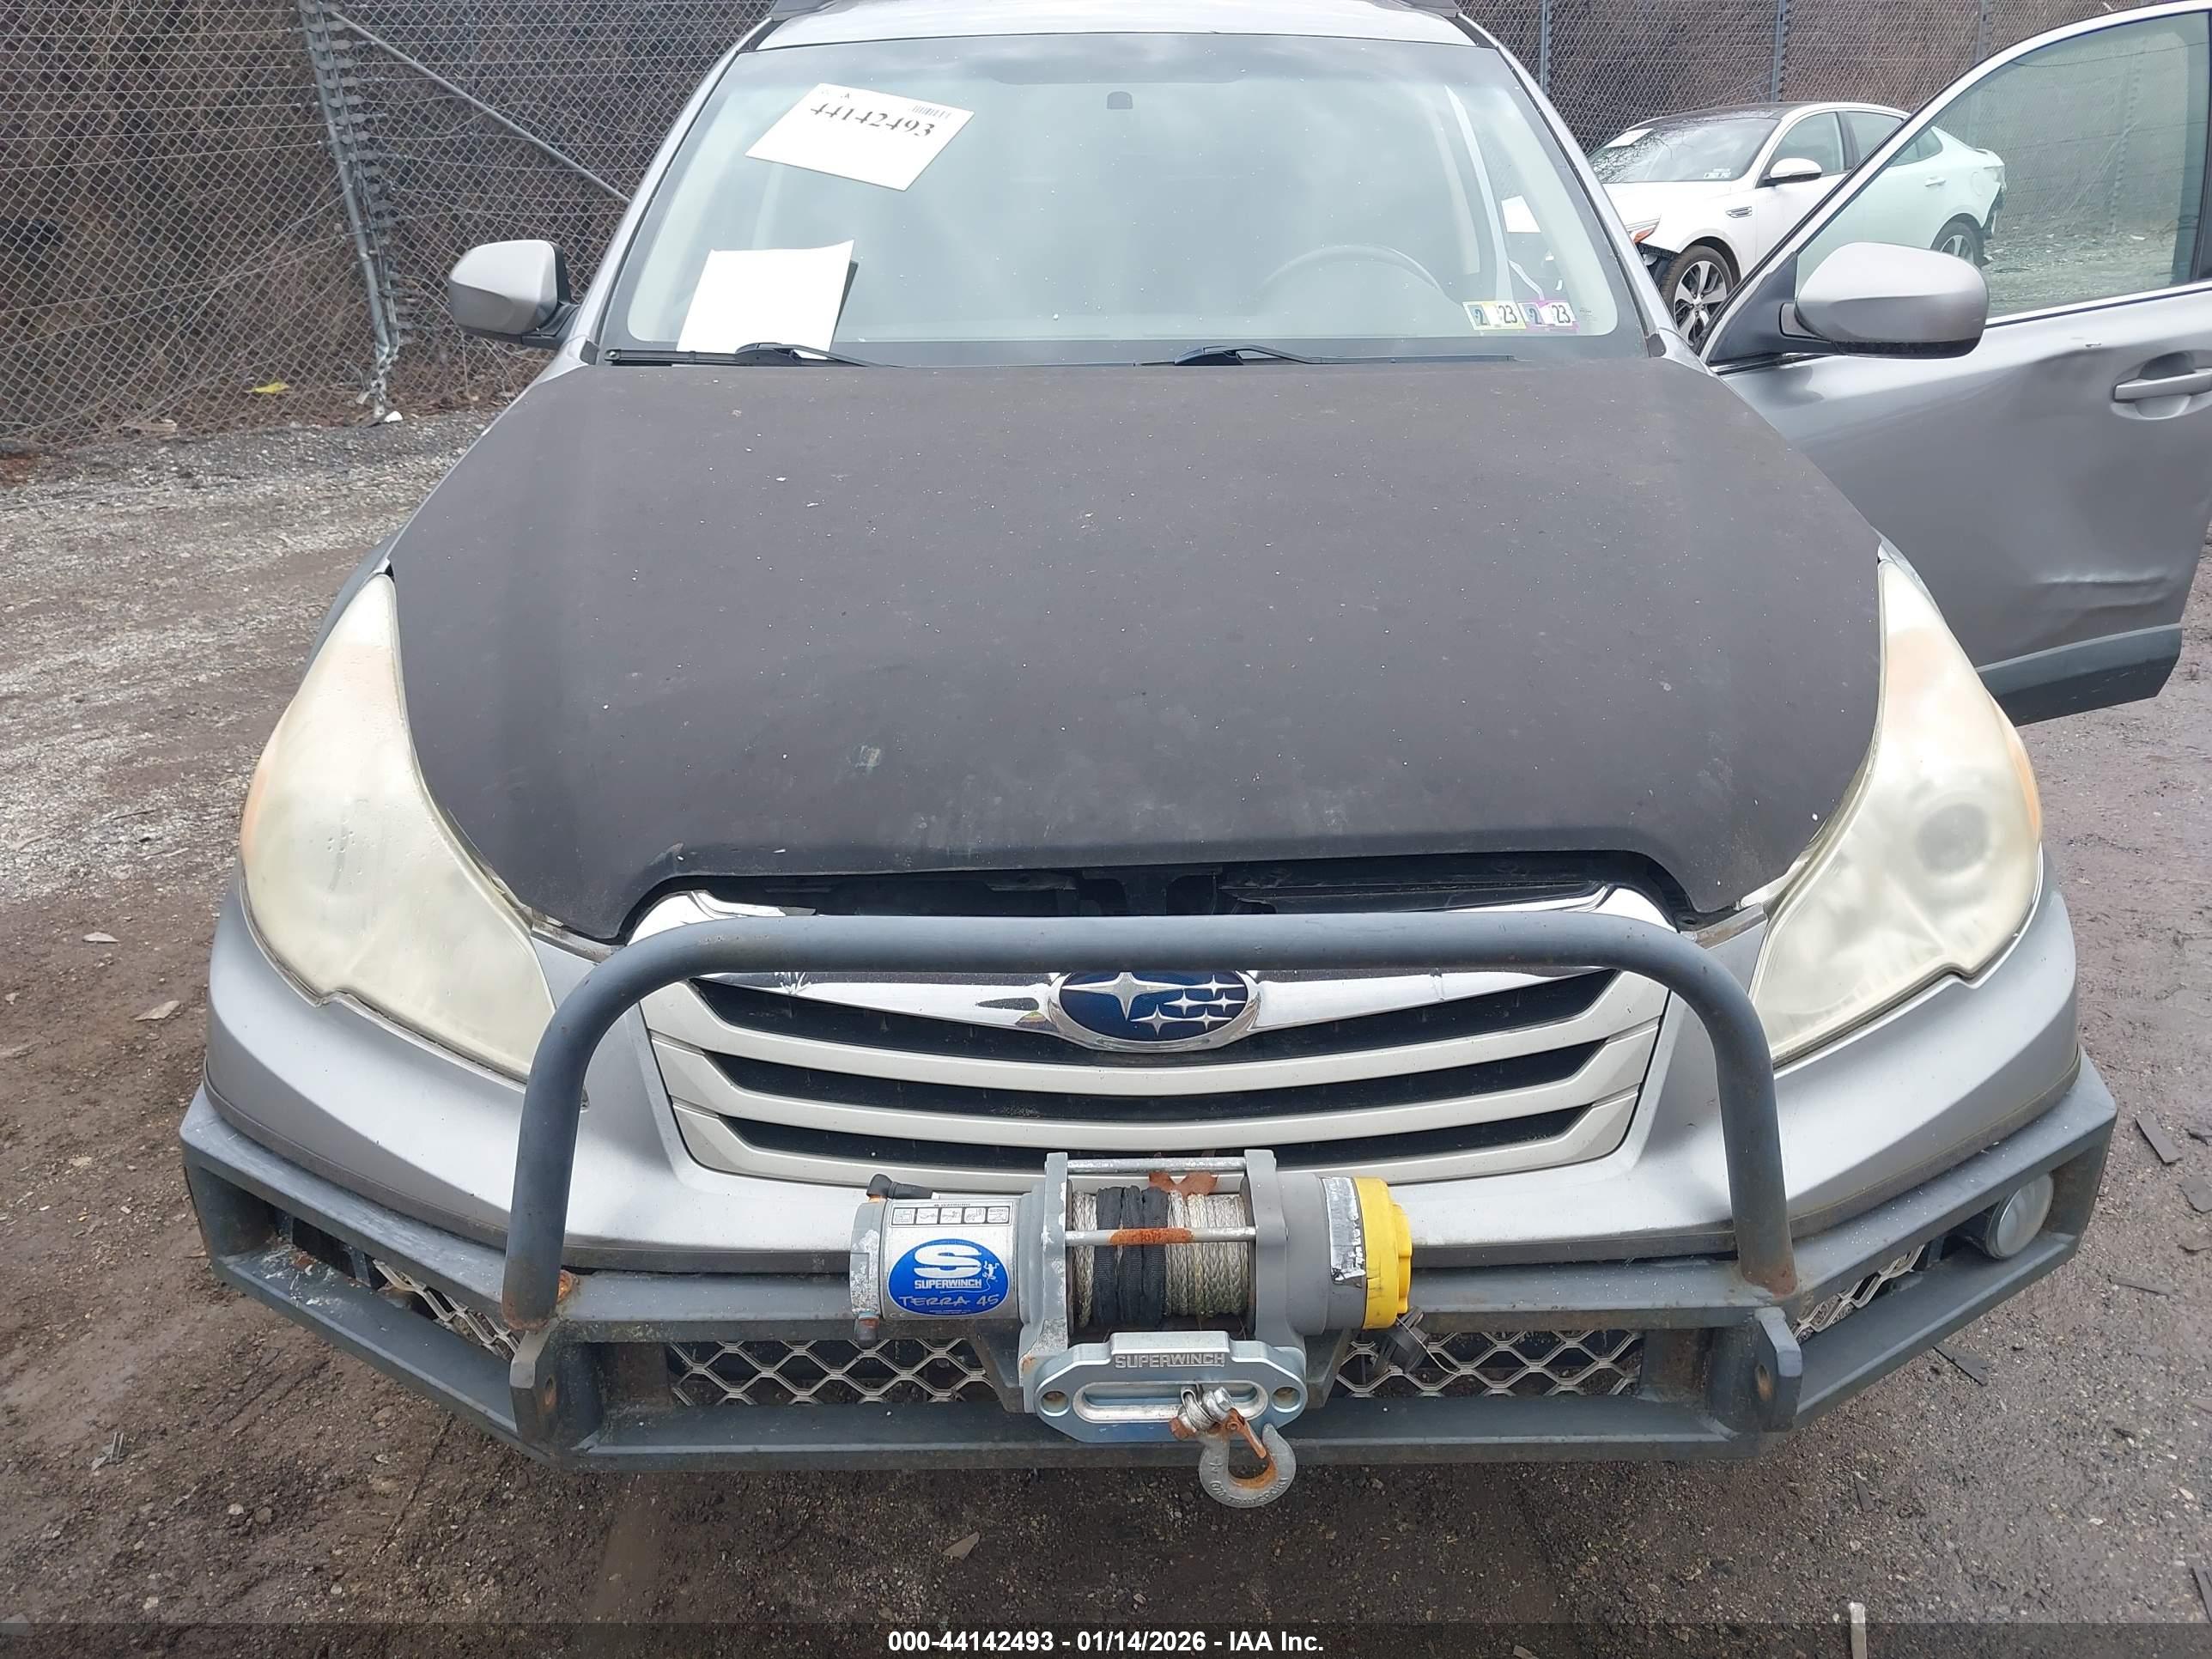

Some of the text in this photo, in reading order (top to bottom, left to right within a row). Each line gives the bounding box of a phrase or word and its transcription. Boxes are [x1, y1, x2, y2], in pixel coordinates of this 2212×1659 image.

[811, 103, 934, 136] 44142493
[1498, 305, 1517, 323] 23
[1551, 305, 1571, 323] 23
[915, 1279, 981, 1290] SUPERWINCH
[898, 1293, 1000, 1307] TERRA 45
[1115, 1353, 1225, 1368] SUPERWINCH
